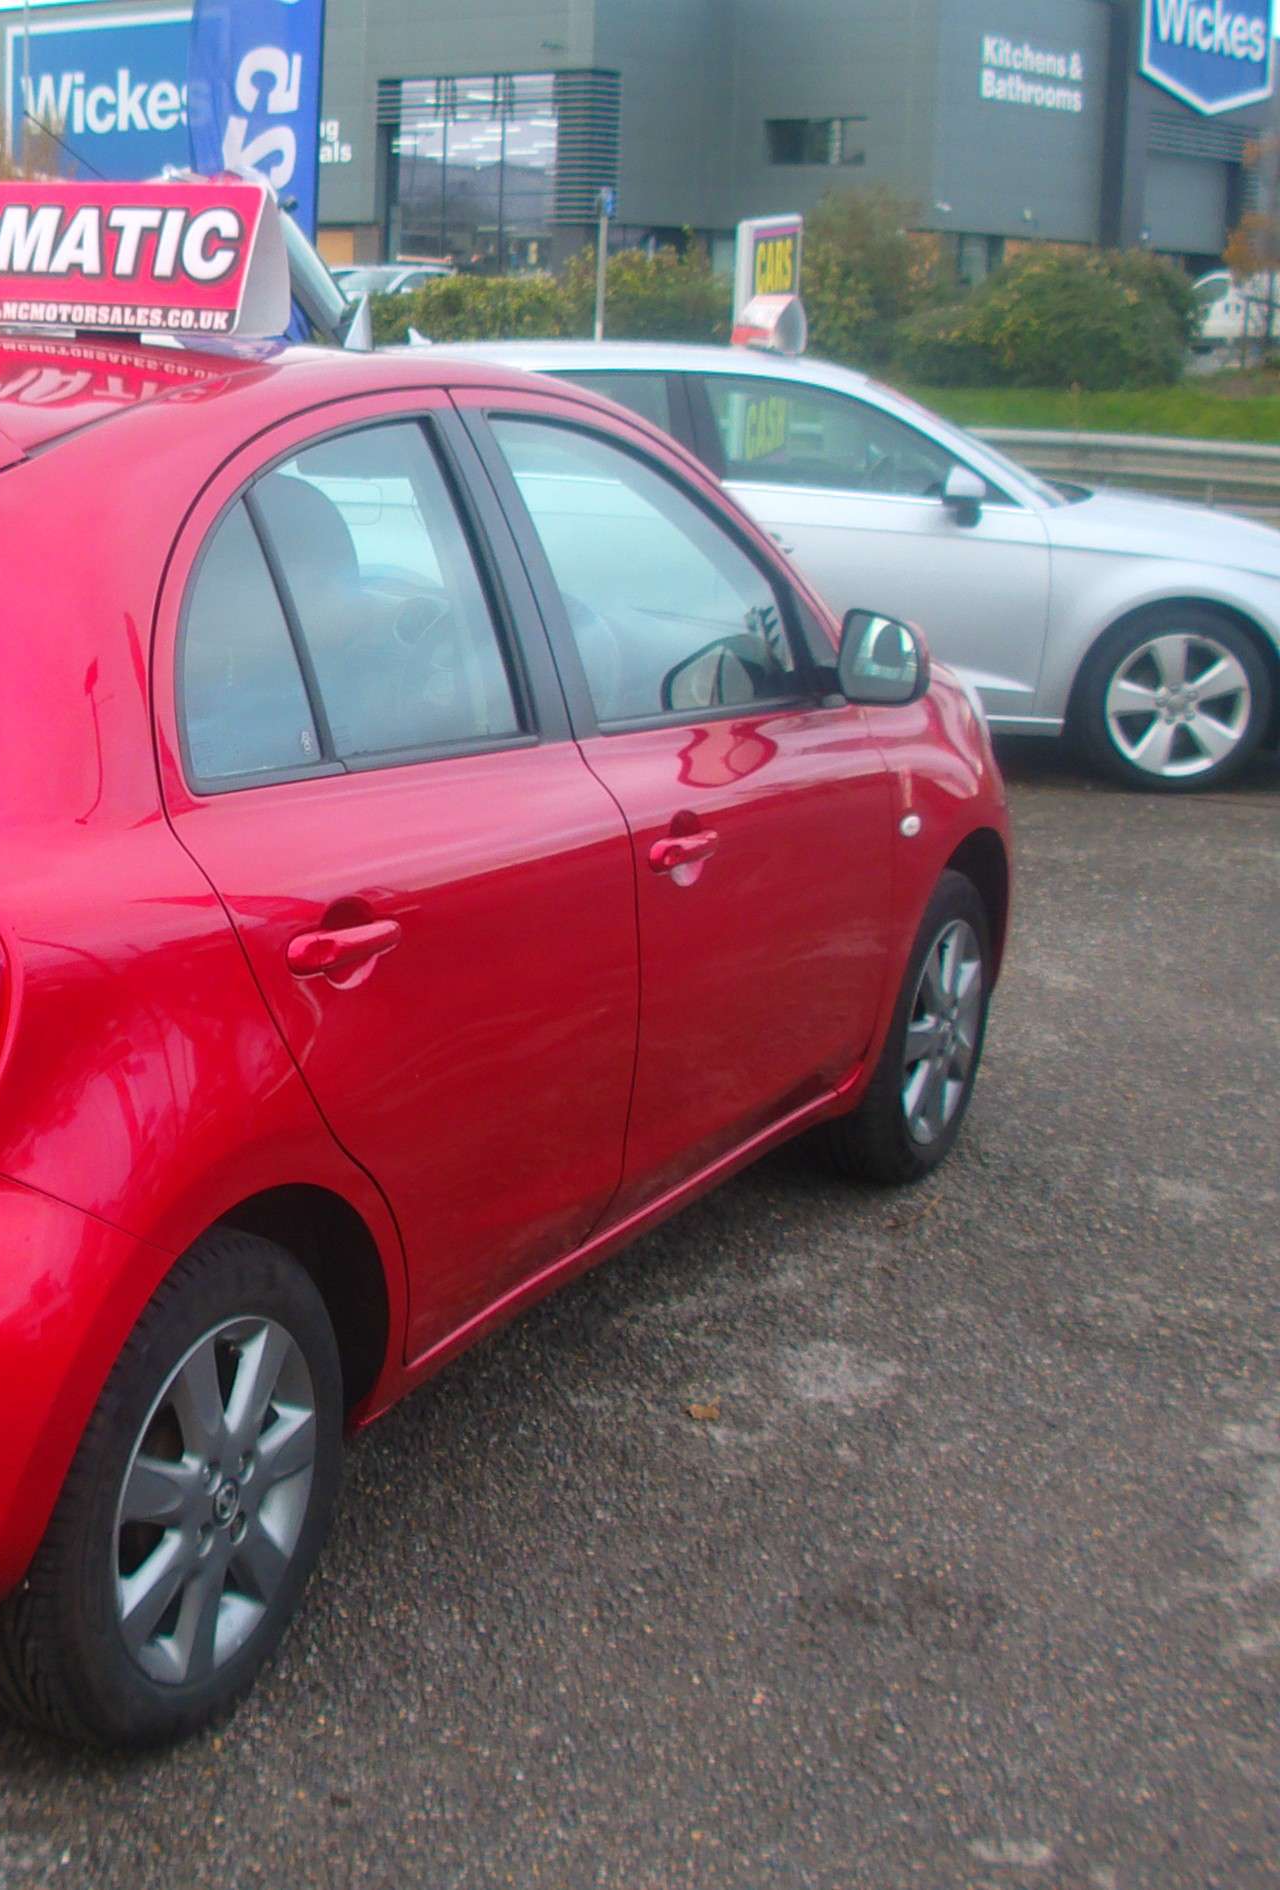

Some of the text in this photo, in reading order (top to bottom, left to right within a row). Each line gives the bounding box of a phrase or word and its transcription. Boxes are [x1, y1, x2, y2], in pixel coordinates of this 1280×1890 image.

[1157, 0, 1266, 62] Wickes
[983, 34, 1083, 80] Kitchens &
[982, 68, 1082, 112] Bathrooms
